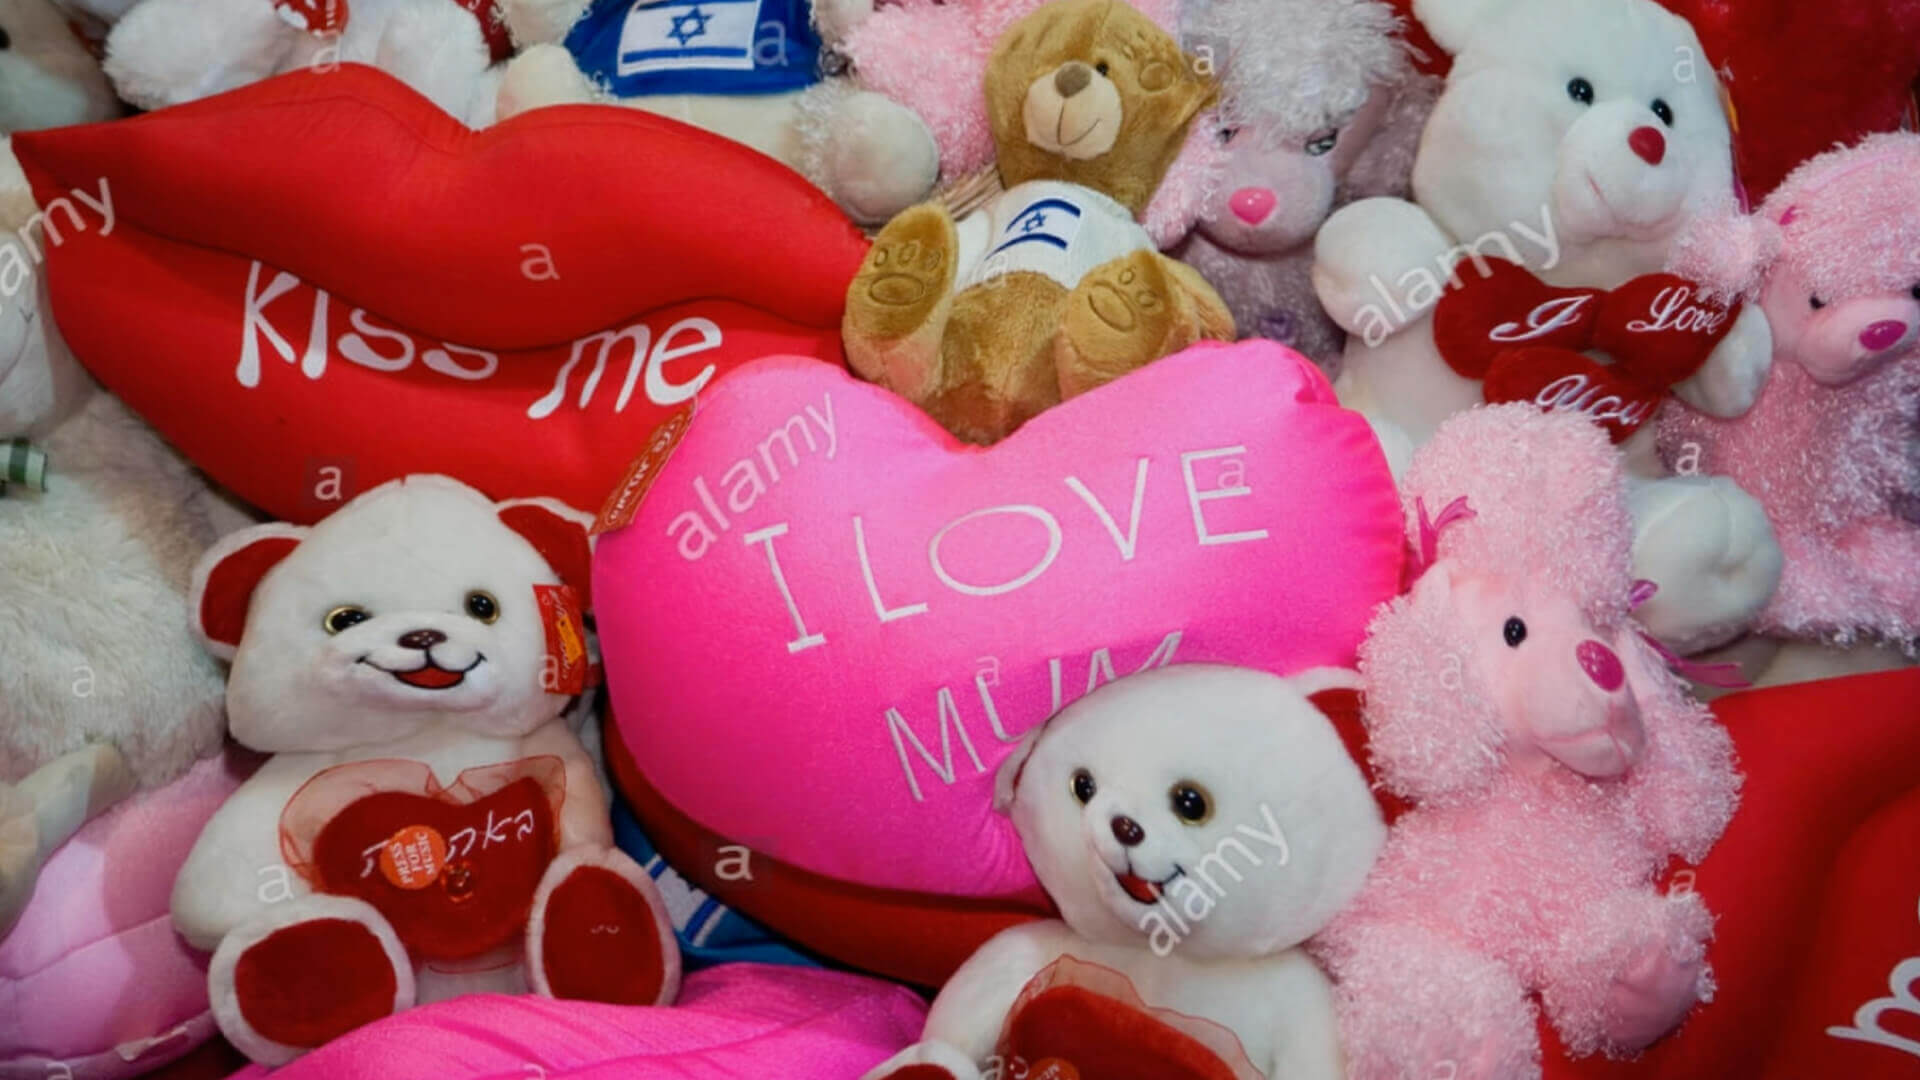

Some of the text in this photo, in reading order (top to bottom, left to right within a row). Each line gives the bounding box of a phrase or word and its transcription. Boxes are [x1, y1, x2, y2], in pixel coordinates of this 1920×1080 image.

[1626, 286, 1727, 335] Love
[527, 317, 722, 419] me
[744, 523, 826, 653] I
[854, 445, 1270, 623] LOVE
